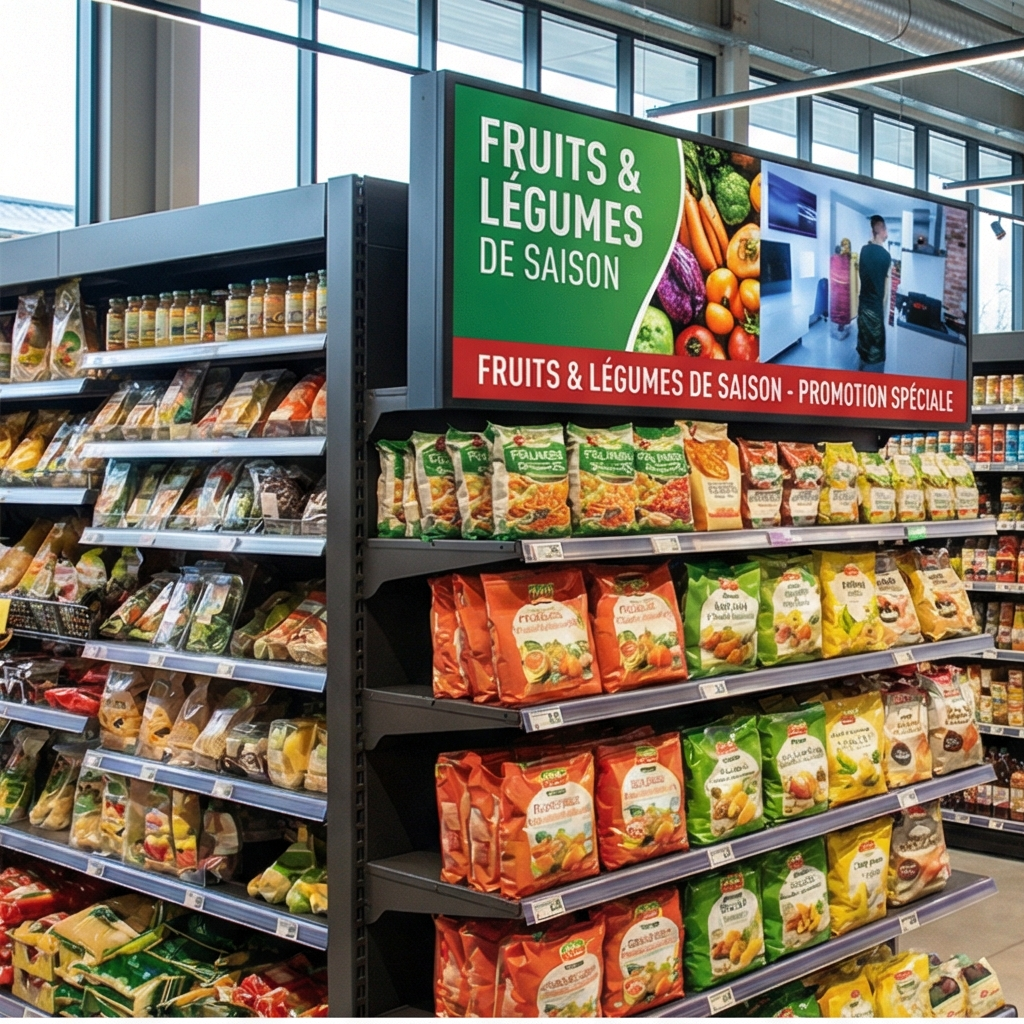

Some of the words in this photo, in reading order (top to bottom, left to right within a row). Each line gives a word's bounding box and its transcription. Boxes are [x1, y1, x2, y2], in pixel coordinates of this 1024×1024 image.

[481, 116, 607, 186] FRUITS
[617, 148, 642, 194] &
[480, 170, 643, 248] LÉGUMES
[480, 236, 514, 277] DE
[524, 243, 619, 291] SAISON
[478, 353, 561, 389] FRUITS
[566, 360, 583, 391] &
[589, 356, 684, 397] LÉGUMES
[689, 370, 713, 398] DE
[717, 372, 782, 402] SAISON
[798, 378, 887, 409] PROMOTION
[891, 381, 954, 413] SPÉCIALE
